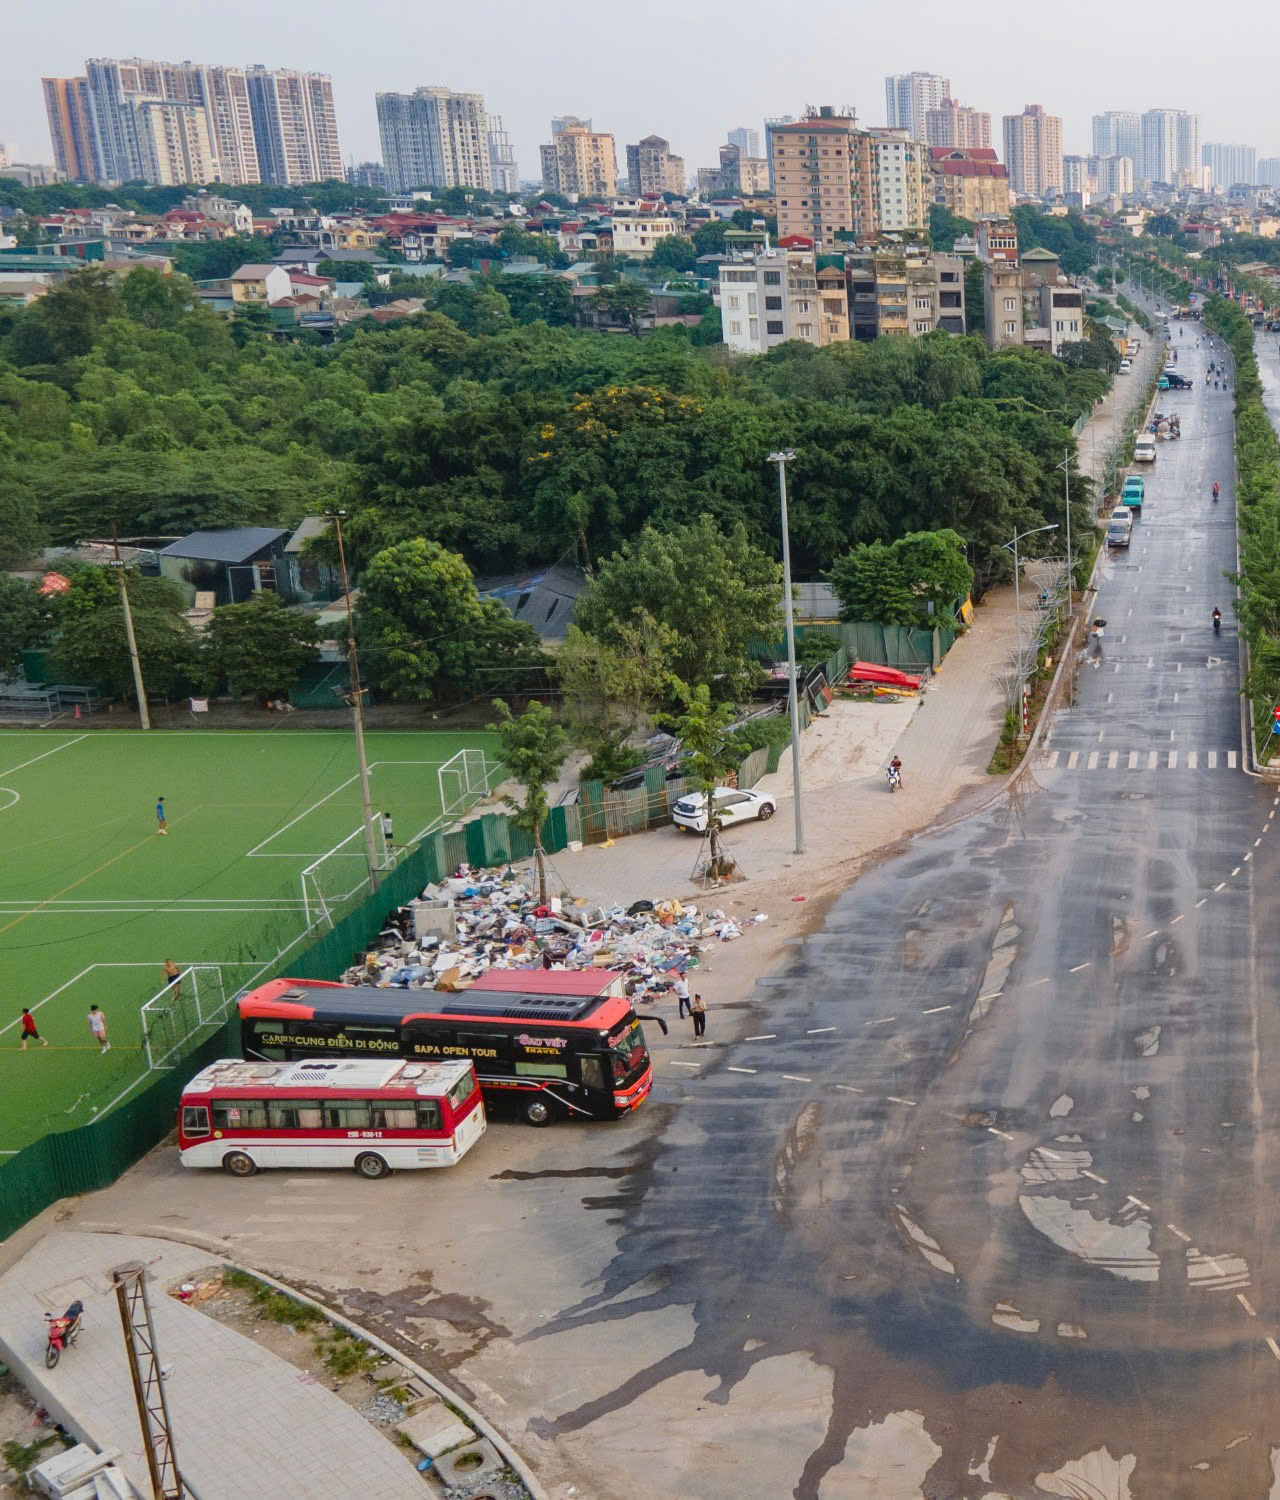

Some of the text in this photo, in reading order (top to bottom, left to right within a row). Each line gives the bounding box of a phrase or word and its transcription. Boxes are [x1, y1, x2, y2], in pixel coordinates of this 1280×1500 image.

[295, 1036, 326, 1046] CUNG
[355, 1040, 366, 1049] DI
[368, 1039, 399, 1050] ĐỘNG
[414, 1045, 497, 1057] SAPA OPEN TOUR
[524, 1046, 561, 1055] TRAVEL
